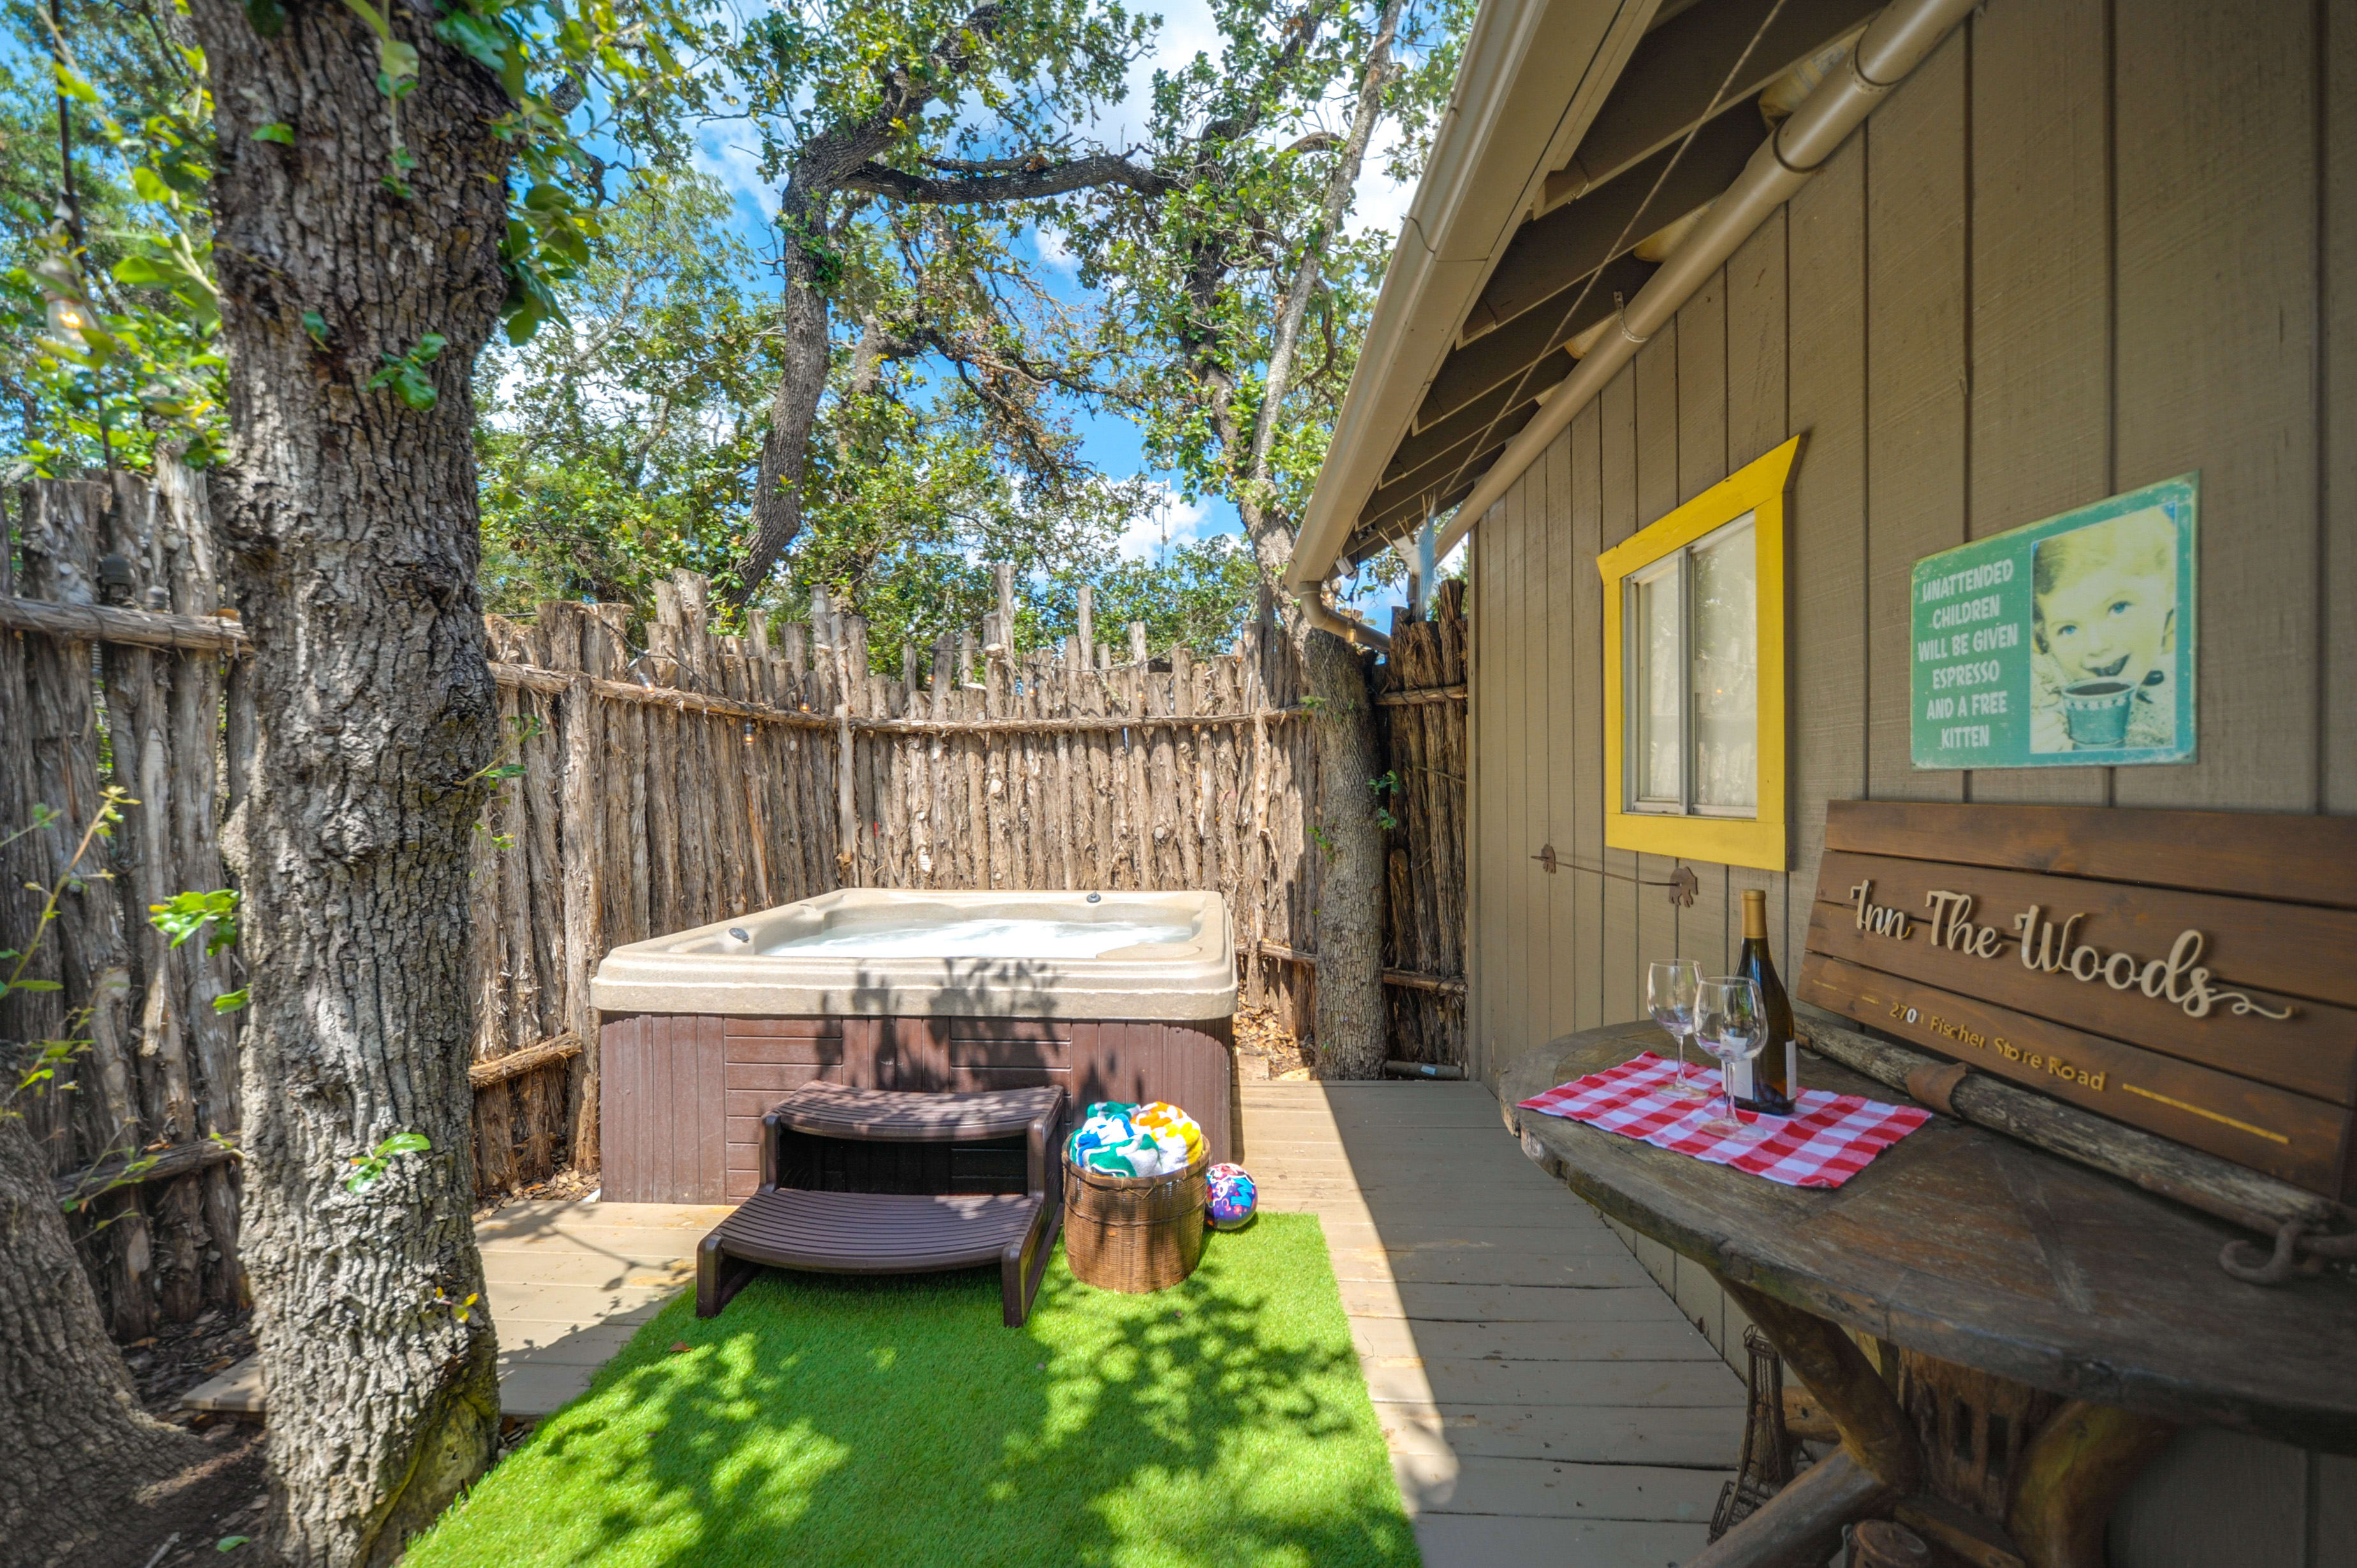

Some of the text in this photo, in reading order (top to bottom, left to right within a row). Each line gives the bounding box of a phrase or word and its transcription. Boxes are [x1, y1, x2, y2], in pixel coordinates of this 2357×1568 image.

[1922, 558, 2013, 603] UNATTENDED
[1933, 594, 2000, 629] CHILDREN
[1918, 623, 2018, 662] WILL BE GIVEN
[1933, 660, 2000, 690] ESPRESSO
[1926, 690, 2008, 720] AND A FREE
[1941, 725, 1990, 748] KITTEN
[1850, 880, 2291, 1019] Inn The Woods
[1994, 1037, 2042, 1069] Store
[2048, 1056, 2106, 1091] Road
